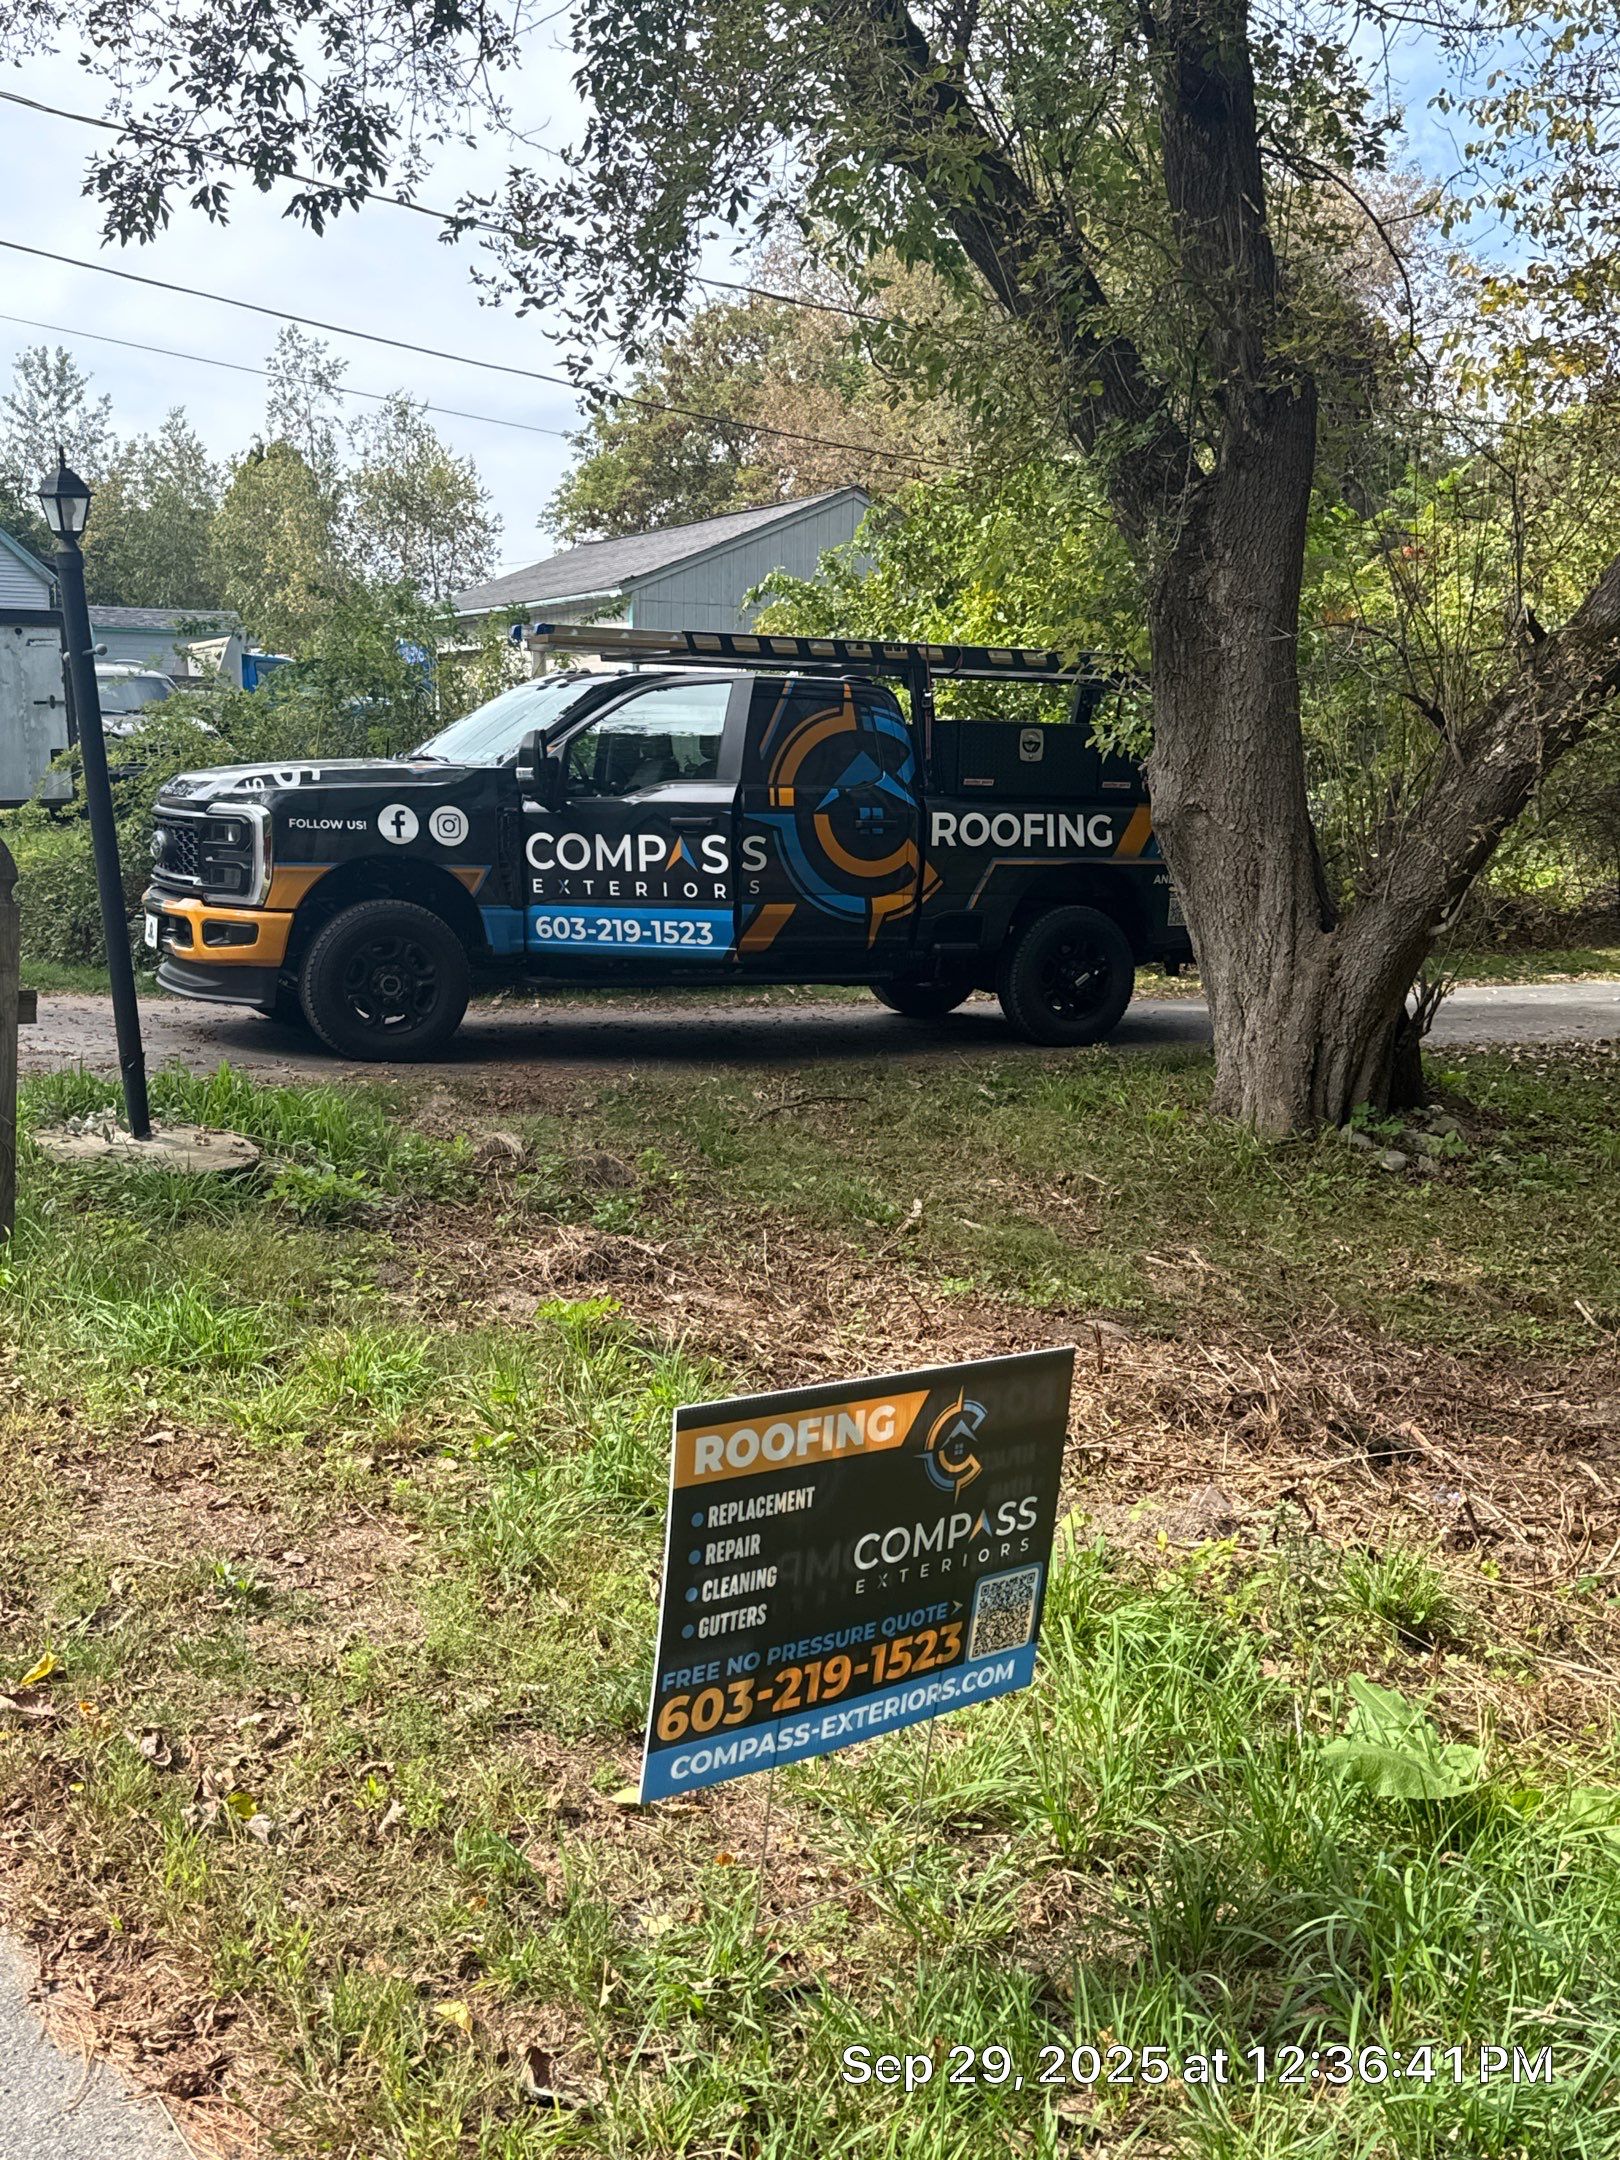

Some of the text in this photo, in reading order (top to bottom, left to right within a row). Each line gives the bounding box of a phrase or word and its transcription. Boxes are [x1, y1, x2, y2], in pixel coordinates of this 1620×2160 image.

[288, 817, 367, 830] FOLLOW US!
[931, 811, 1113, 848] ROOFING
[525, 832, 768, 875] COMPASS
[532, 878, 760, 899] EXTERIORS
[535, 916, 713, 945] 603-219-1523
[693, 1404, 897, 1476] ROOFING
[707, 1485, 816, 1529] REPLACEMENT
[704, 1533, 761, 1566] REPAIR
[852, 1495, 1039, 1571] COMPASS
[701, 1565, 778, 1603] CLEANING
[854, 1537, 1031, 1595] EXTERIORS
[697, 1603, 768, 1640] GUTTERS
[661, 1602, 948, 1693] FREE NO PRESSURE QUOTE
[656, 1621, 964, 1742] 603-219-1523
[669, 1659, 1016, 1780] COMPASS-EXTERIORS.COM
